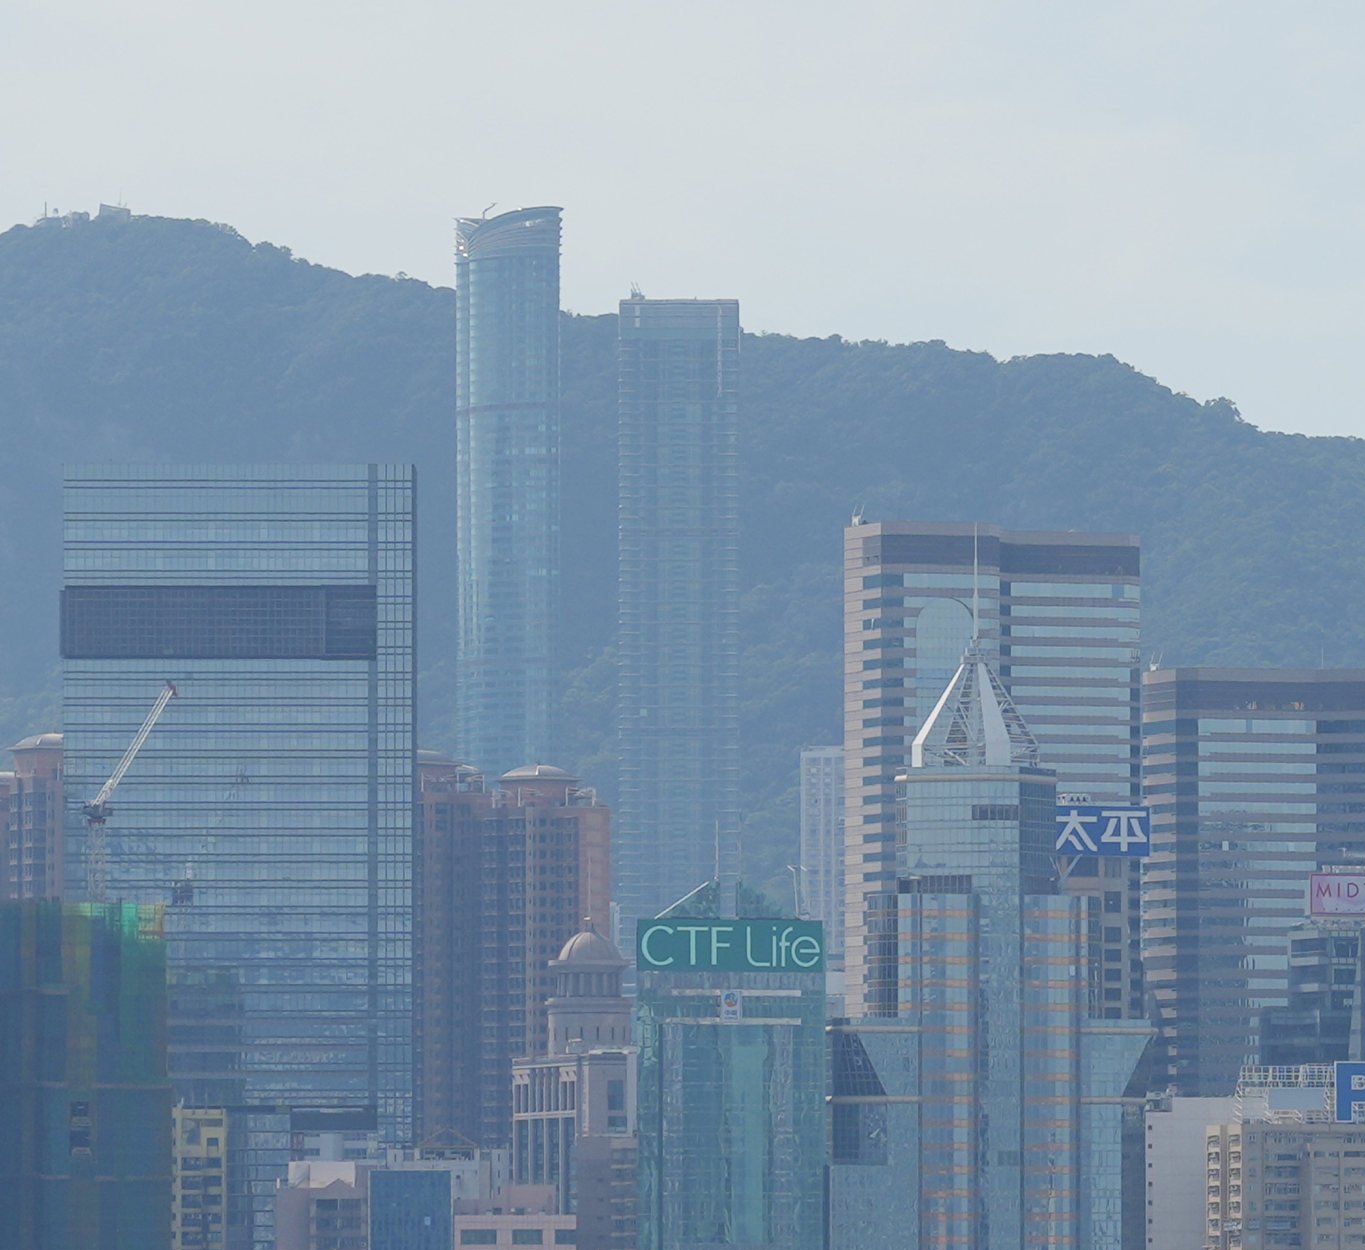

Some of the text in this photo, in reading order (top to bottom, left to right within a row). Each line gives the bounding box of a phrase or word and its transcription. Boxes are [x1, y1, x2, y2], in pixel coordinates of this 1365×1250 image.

[1056, 810, 1147, 852] 太平
[641, 925, 820, 967] CTF Life
